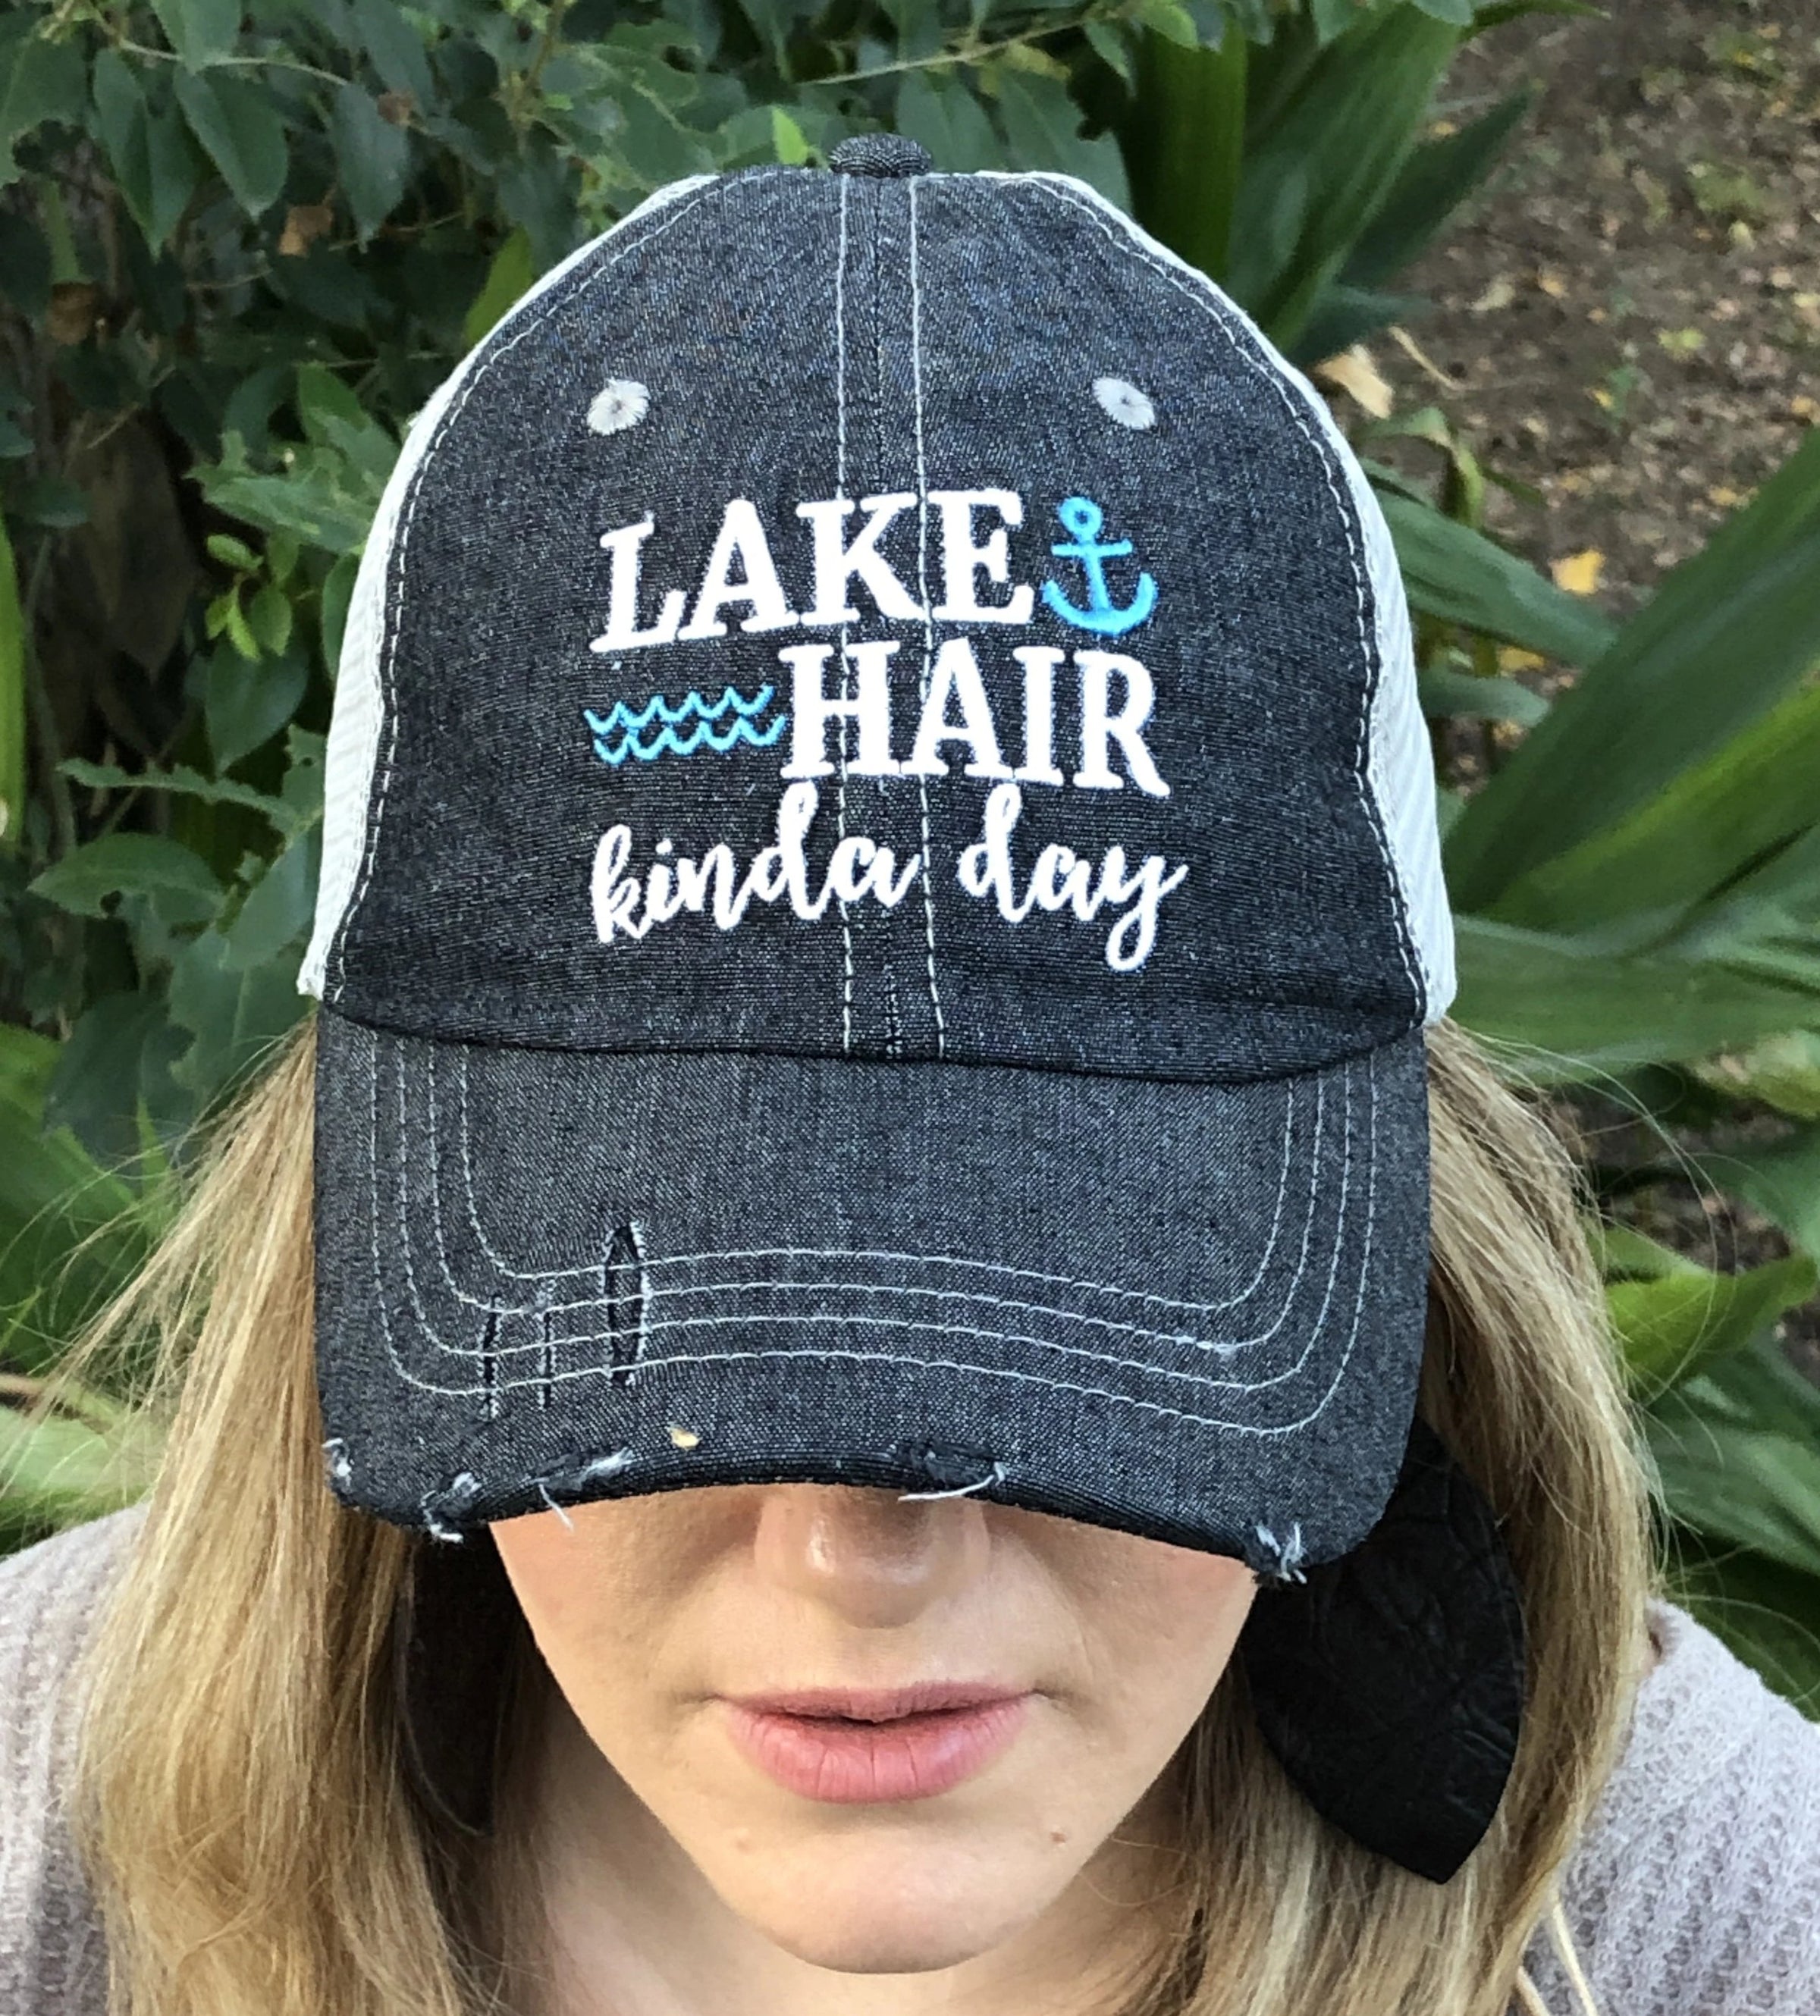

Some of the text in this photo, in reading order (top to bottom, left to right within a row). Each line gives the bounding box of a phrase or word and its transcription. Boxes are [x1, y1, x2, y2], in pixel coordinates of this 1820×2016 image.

[589, 489, 1034, 653] LAKE
[778, 637, 1171, 797] HAIR
[589, 781, 1190, 972] kinda day
